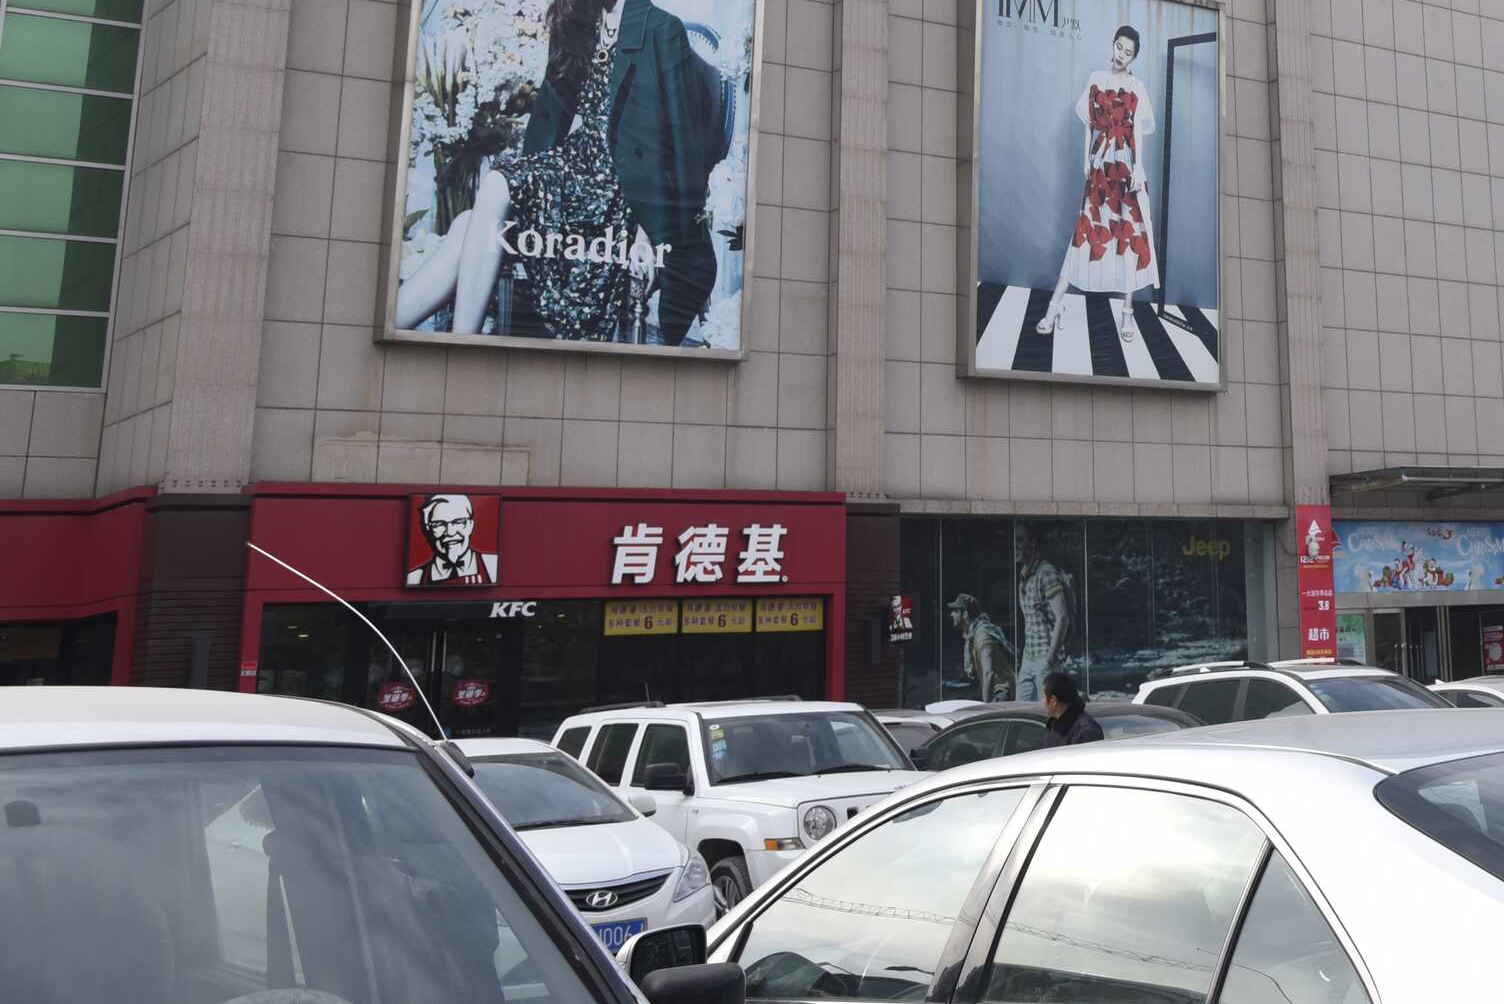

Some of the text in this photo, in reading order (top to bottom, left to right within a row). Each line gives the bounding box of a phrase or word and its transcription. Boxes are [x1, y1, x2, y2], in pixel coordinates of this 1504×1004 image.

[490, 218, 673, 269] Koradior
[611, 523, 788, 584] 肯德基
[1182, 534, 1232, 561] Jeep
[488, 601, 537, 618] KFC
[1308, 627, 1330, 641] 超市
